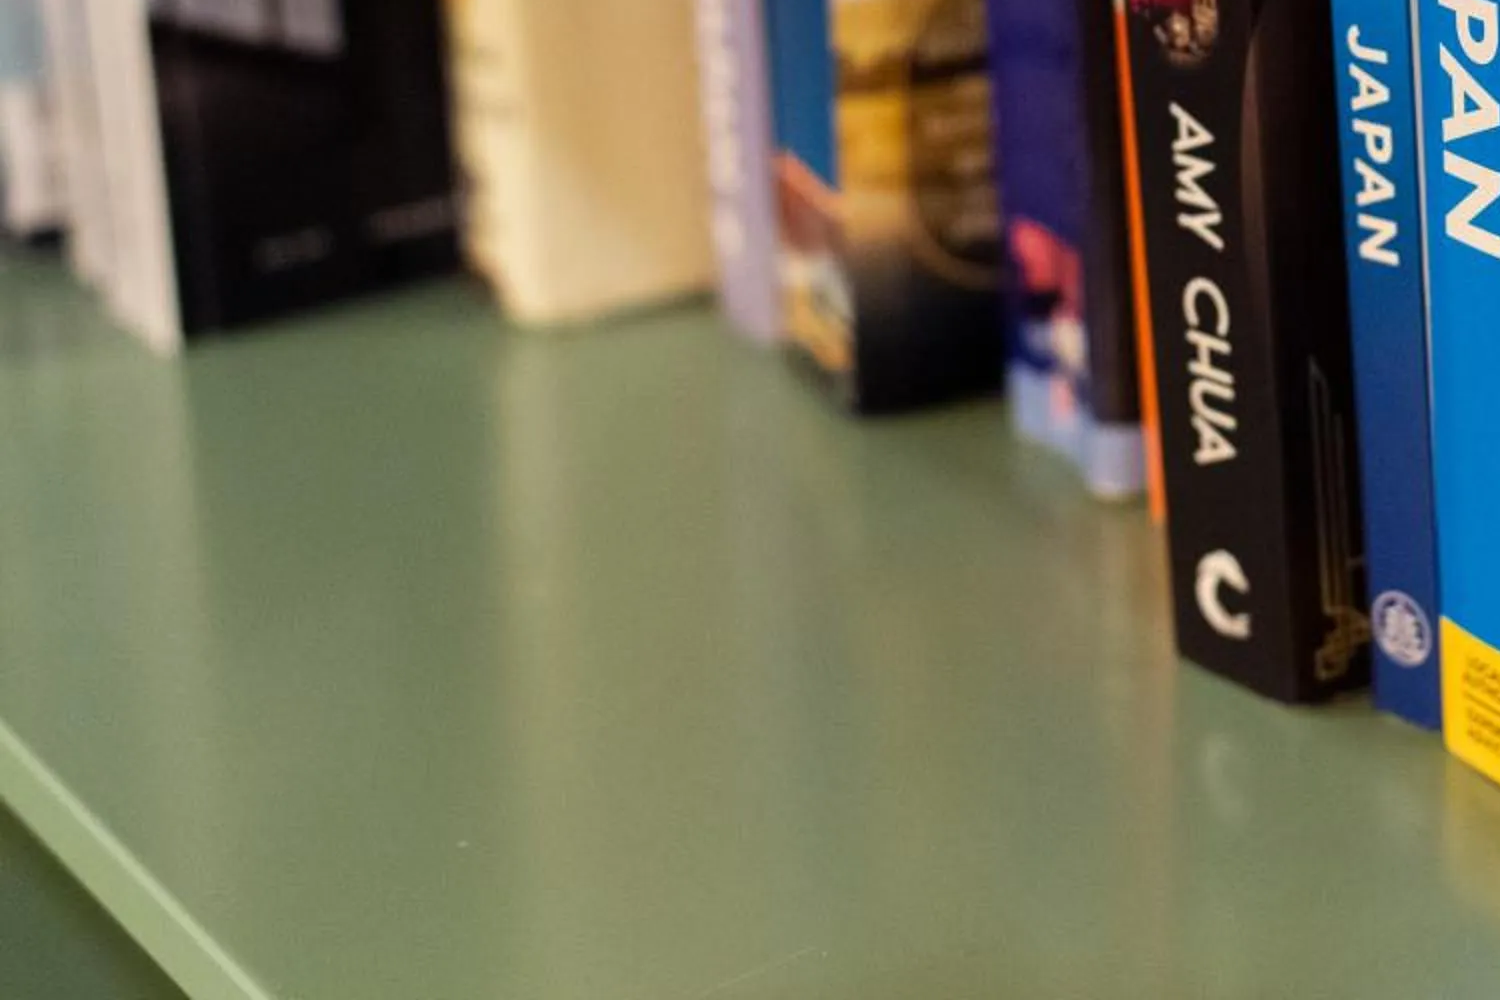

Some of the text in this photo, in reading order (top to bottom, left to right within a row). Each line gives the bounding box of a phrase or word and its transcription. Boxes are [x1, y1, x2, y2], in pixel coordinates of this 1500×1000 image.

[1169, 101, 1239, 465] AMY CHUA
[1346, 23, 1401, 268] JAPAN
